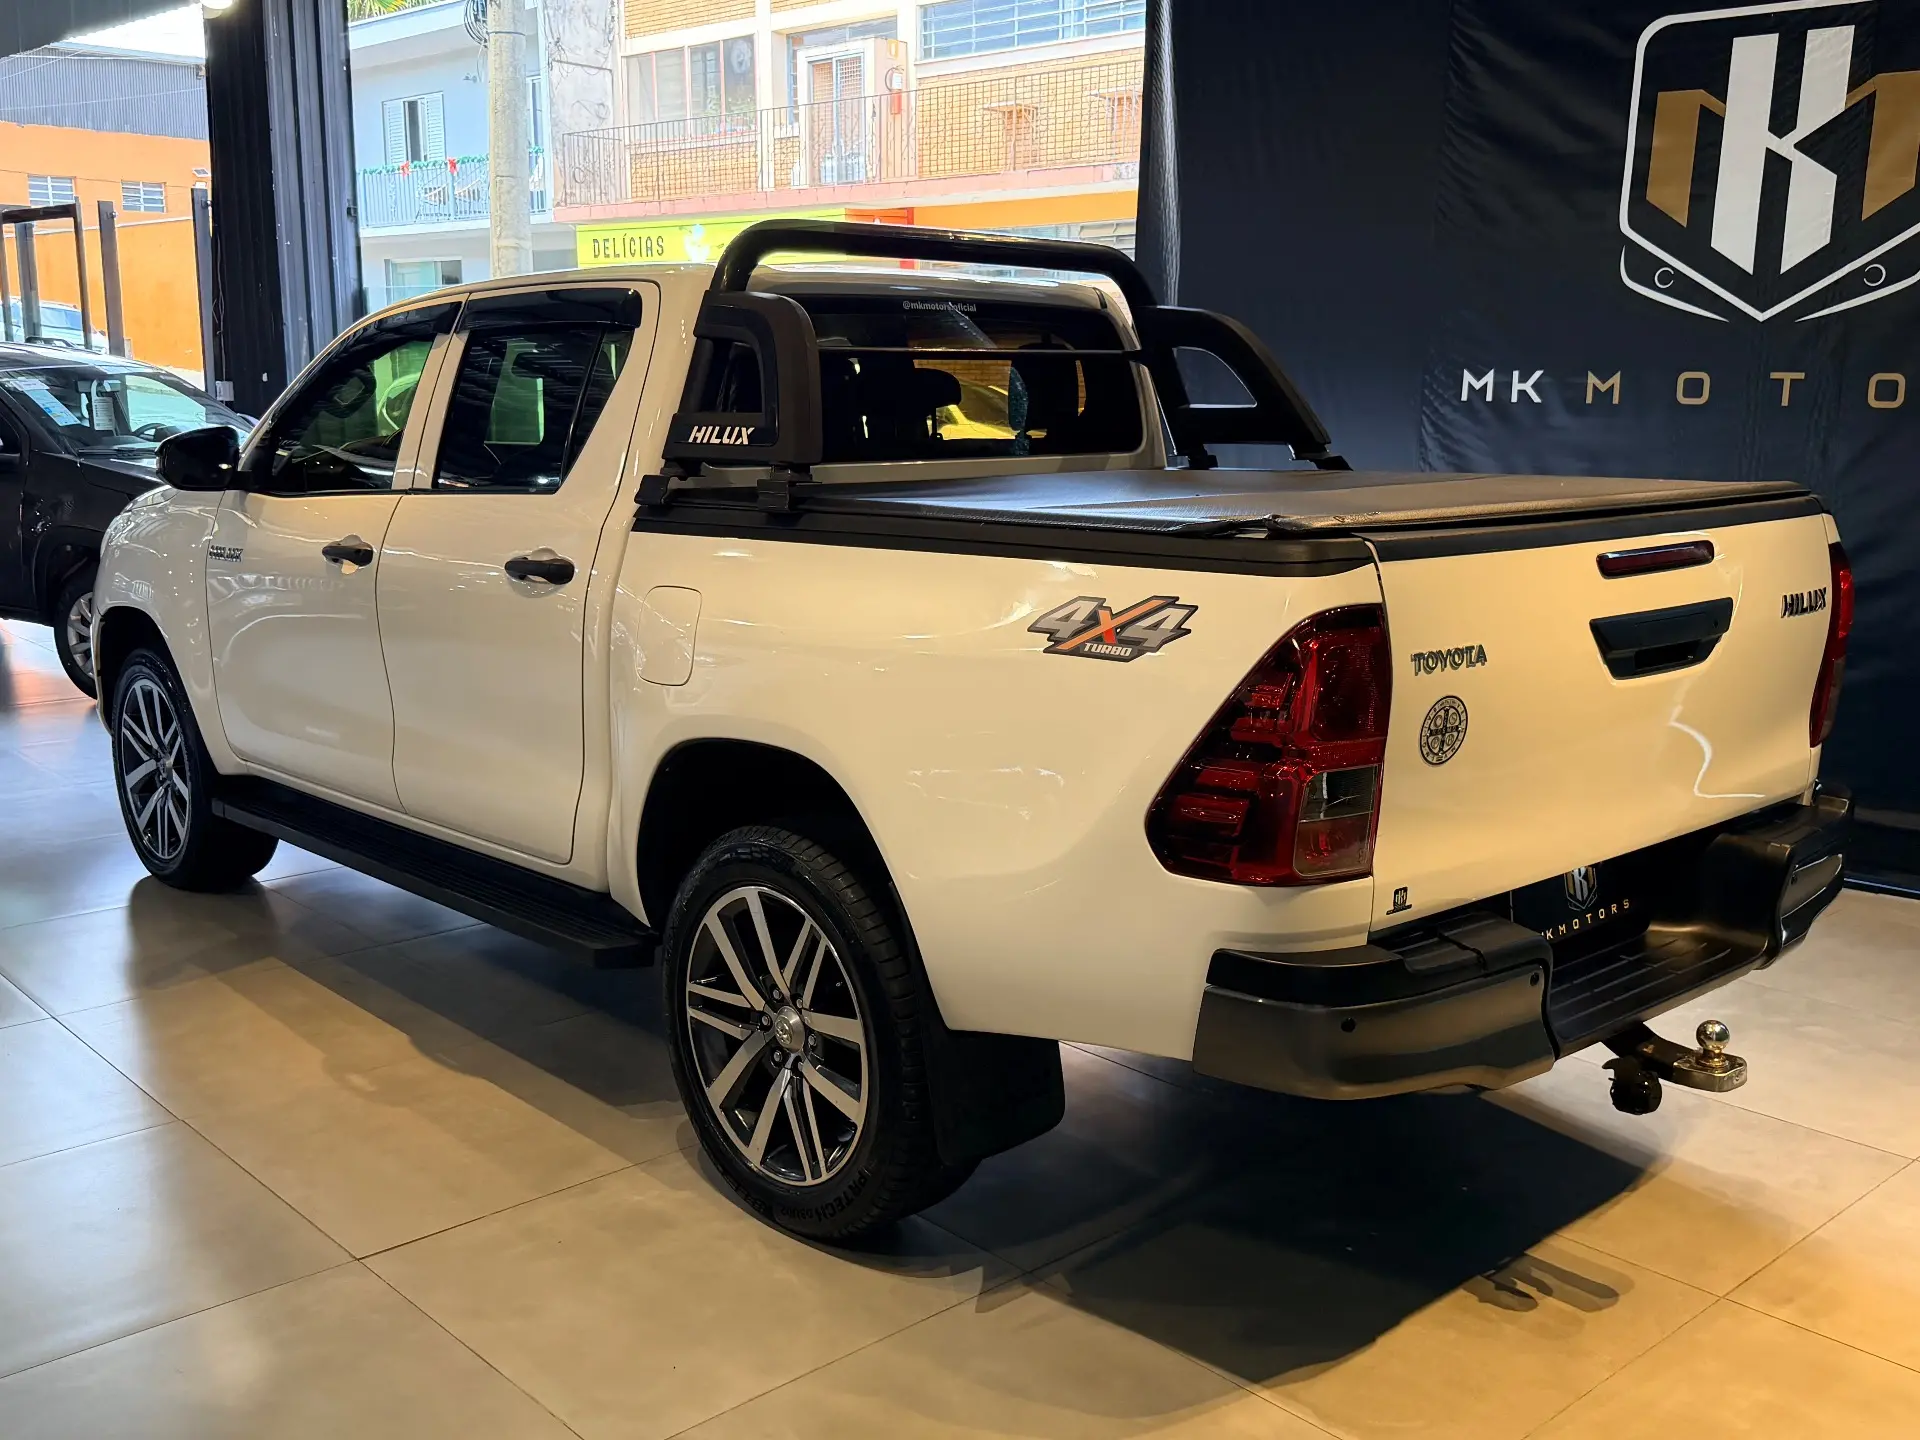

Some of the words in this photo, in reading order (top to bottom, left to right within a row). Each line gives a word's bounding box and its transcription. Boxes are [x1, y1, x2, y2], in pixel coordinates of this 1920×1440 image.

[592, 233, 665, 259] DELÍCIAS
[1460, 368, 1544, 403] MK
[688, 425, 755, 445] HILUX
[1780, 586, 1827, 618] HILUX
[1084, 642, 1133, 657] TURBO
[1410, 644, 1488, 676] TOYOTA
[1559, 899, 1630, 935] MOTORS
